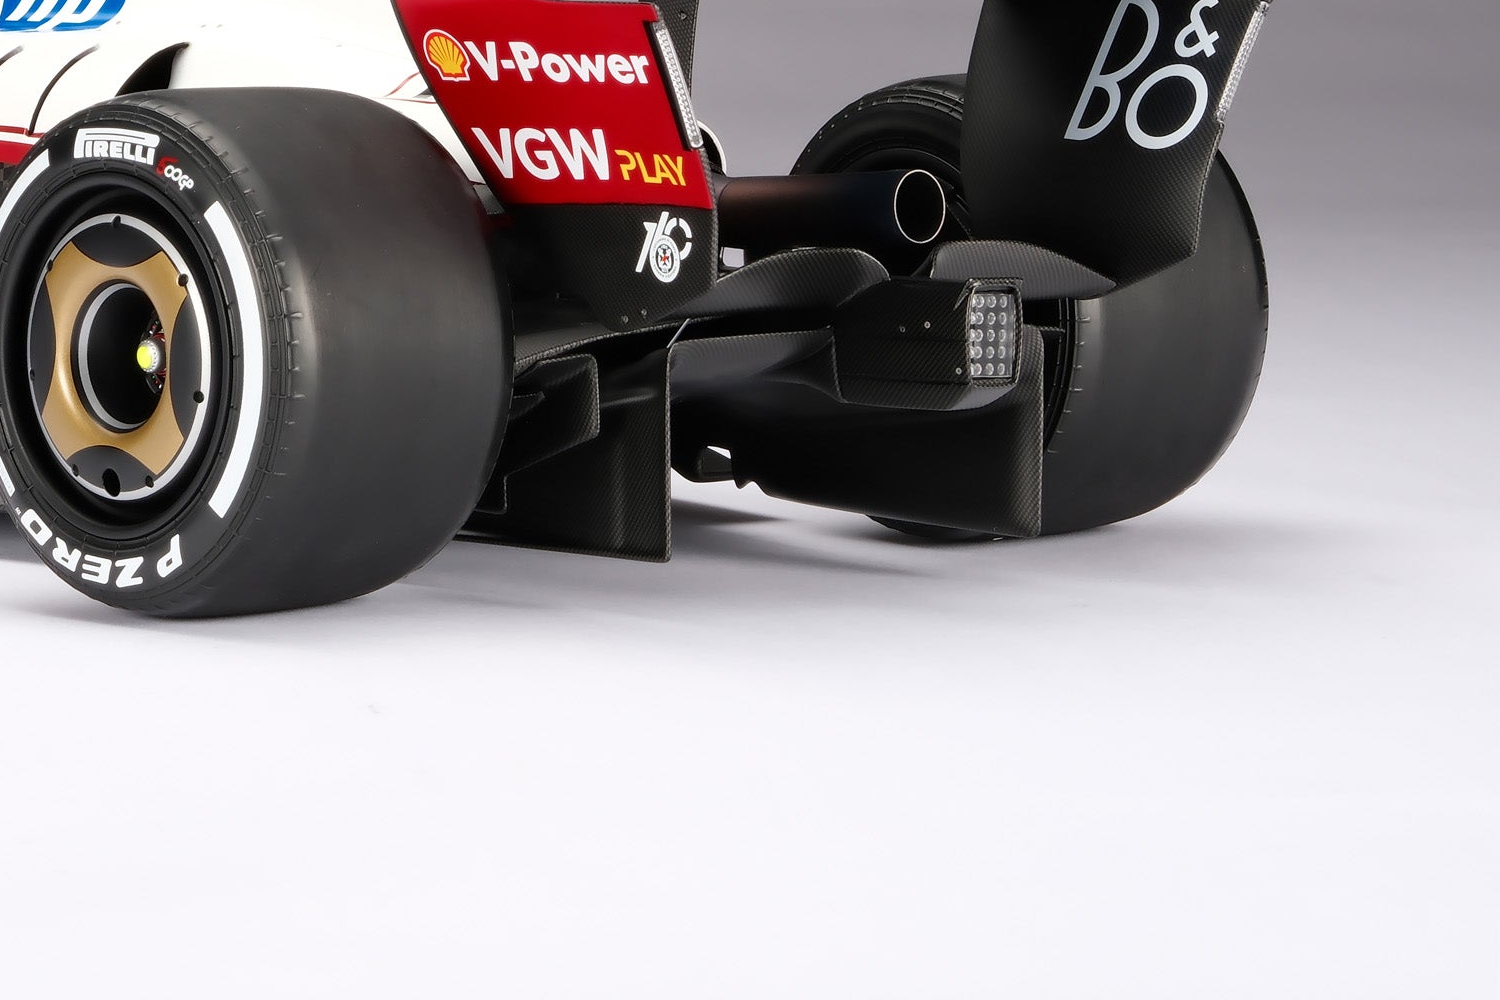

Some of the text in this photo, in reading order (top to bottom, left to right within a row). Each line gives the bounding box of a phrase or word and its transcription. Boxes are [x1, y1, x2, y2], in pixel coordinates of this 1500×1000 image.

[464, 41, 650, 84] V-Power
[74, 128, 160, 165] PIRELLI
[471, 128, 687, 186] VGW PLAY
[20, 508, 183, 588] P ZERO
